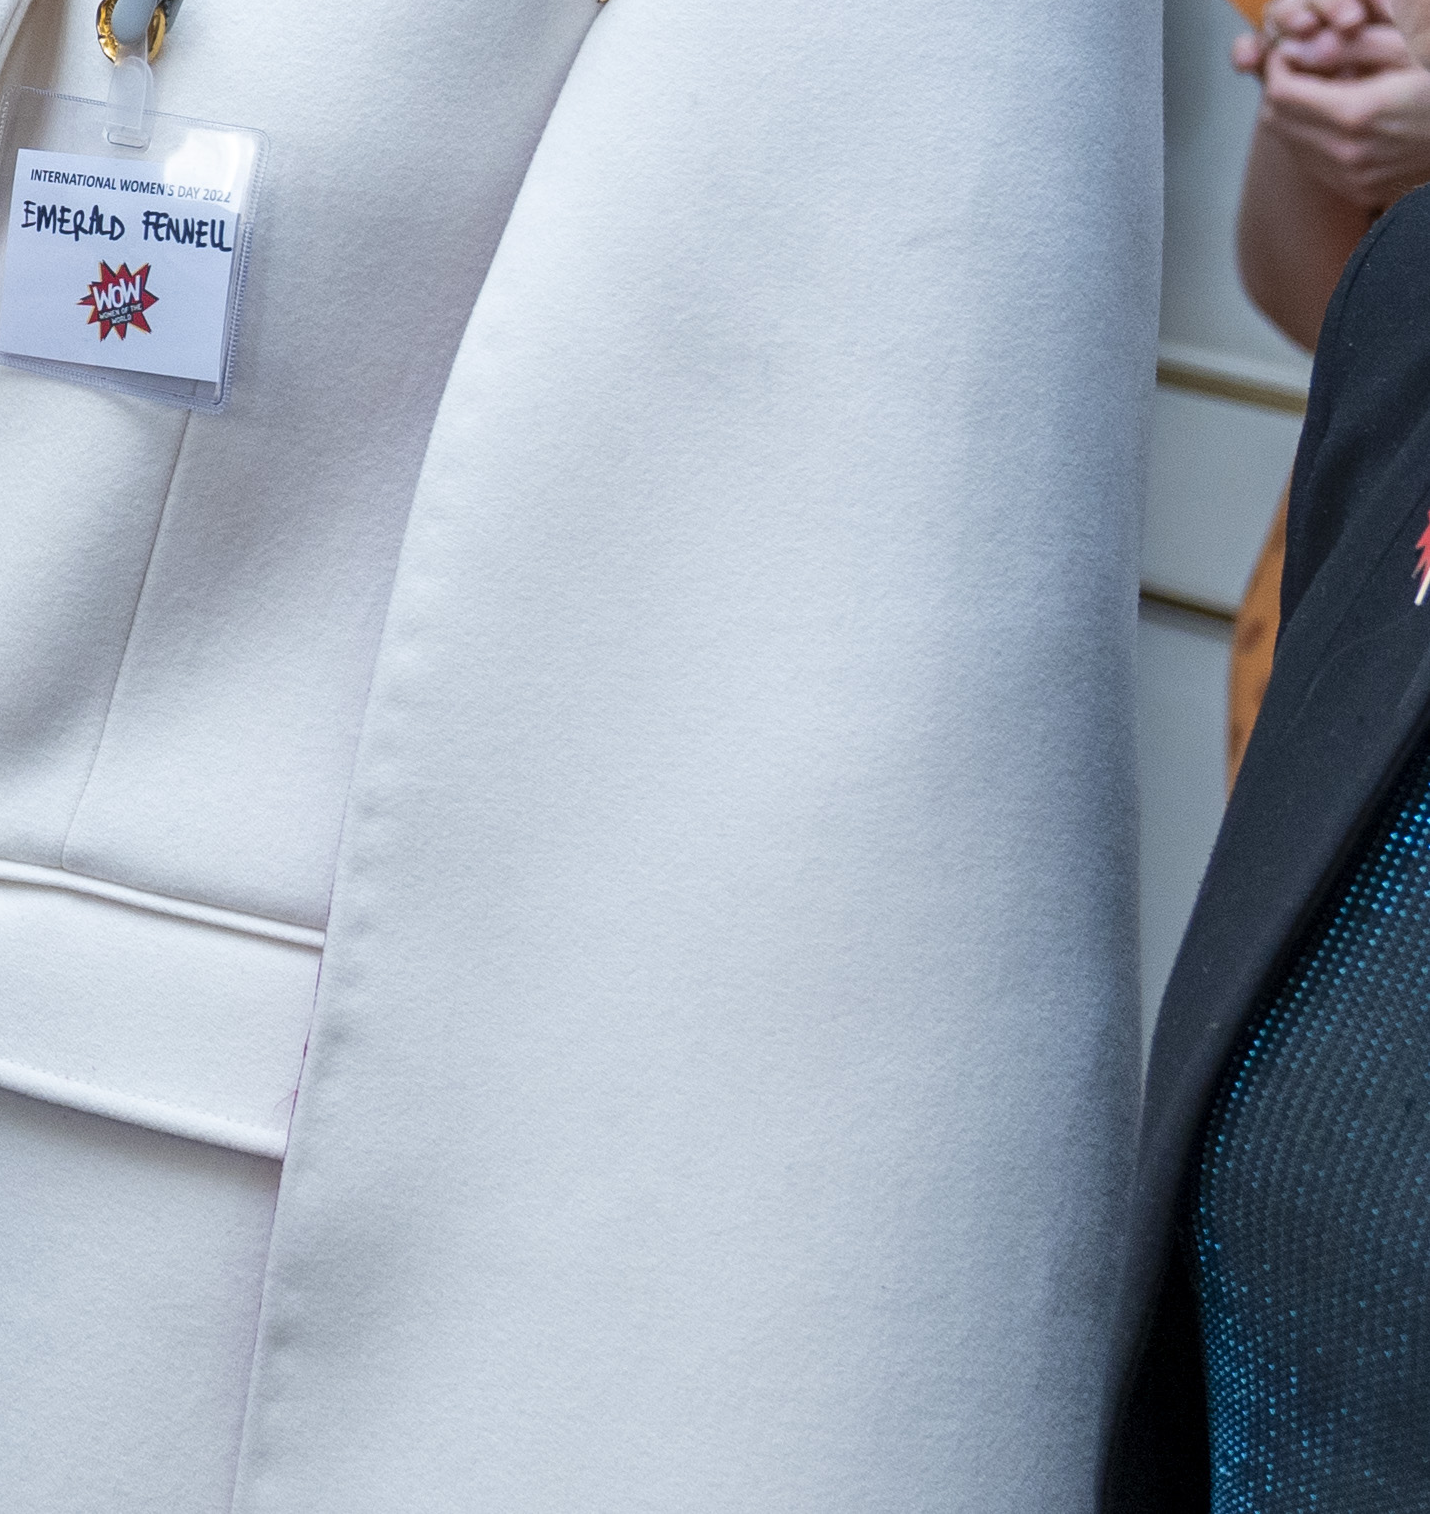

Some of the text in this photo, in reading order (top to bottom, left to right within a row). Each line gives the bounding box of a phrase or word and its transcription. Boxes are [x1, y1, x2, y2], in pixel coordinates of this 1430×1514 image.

[30, 168, 232, 203] INTERNATIONAL WOMEN'S DAY 2022
[21, 200, 233, 252] EMERALD FENNELL
[92, 274, 141, 311] WOW
[99, 302, 143, 320] WOMEN OF THE
[111, 313, 132, 324] WORLD
